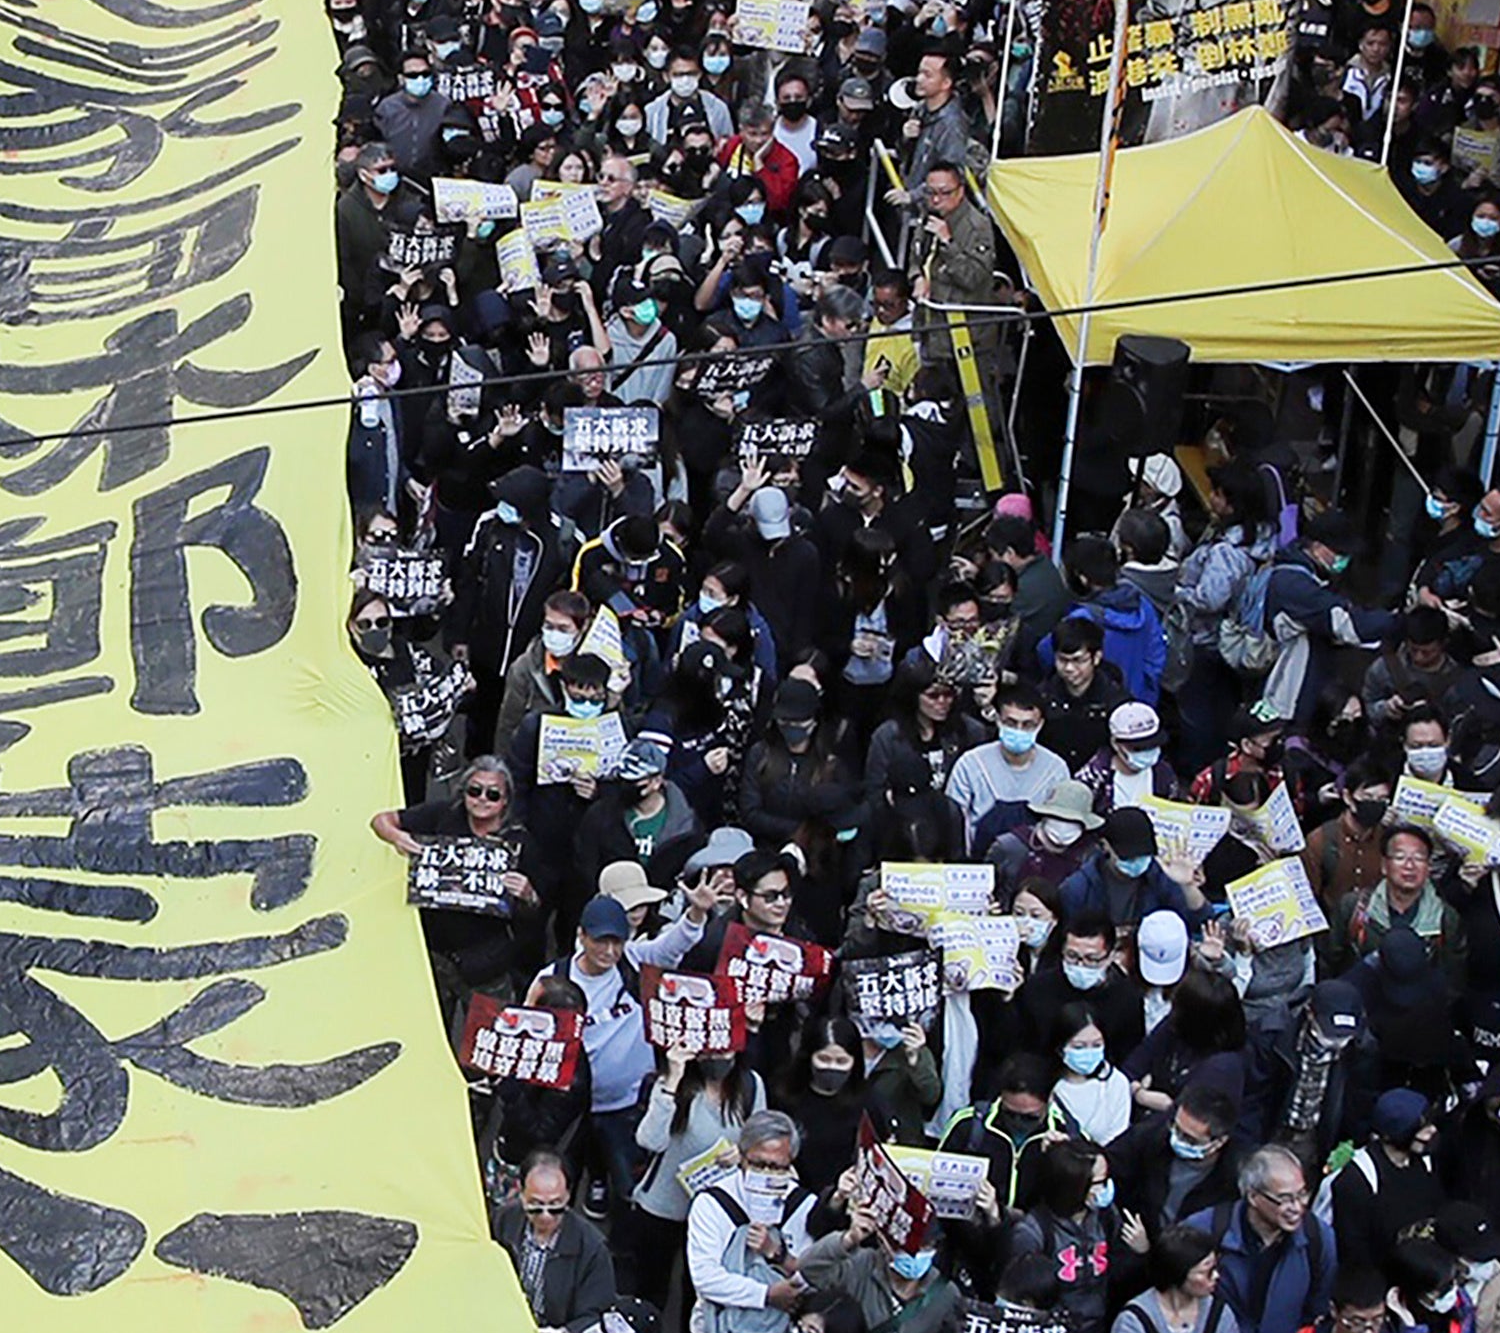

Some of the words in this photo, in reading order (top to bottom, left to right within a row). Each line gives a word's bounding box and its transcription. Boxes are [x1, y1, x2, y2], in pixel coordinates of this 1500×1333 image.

[573, 418, 646, 437] 五大訴求
[420, 846, 506, 872] 五大訴求
